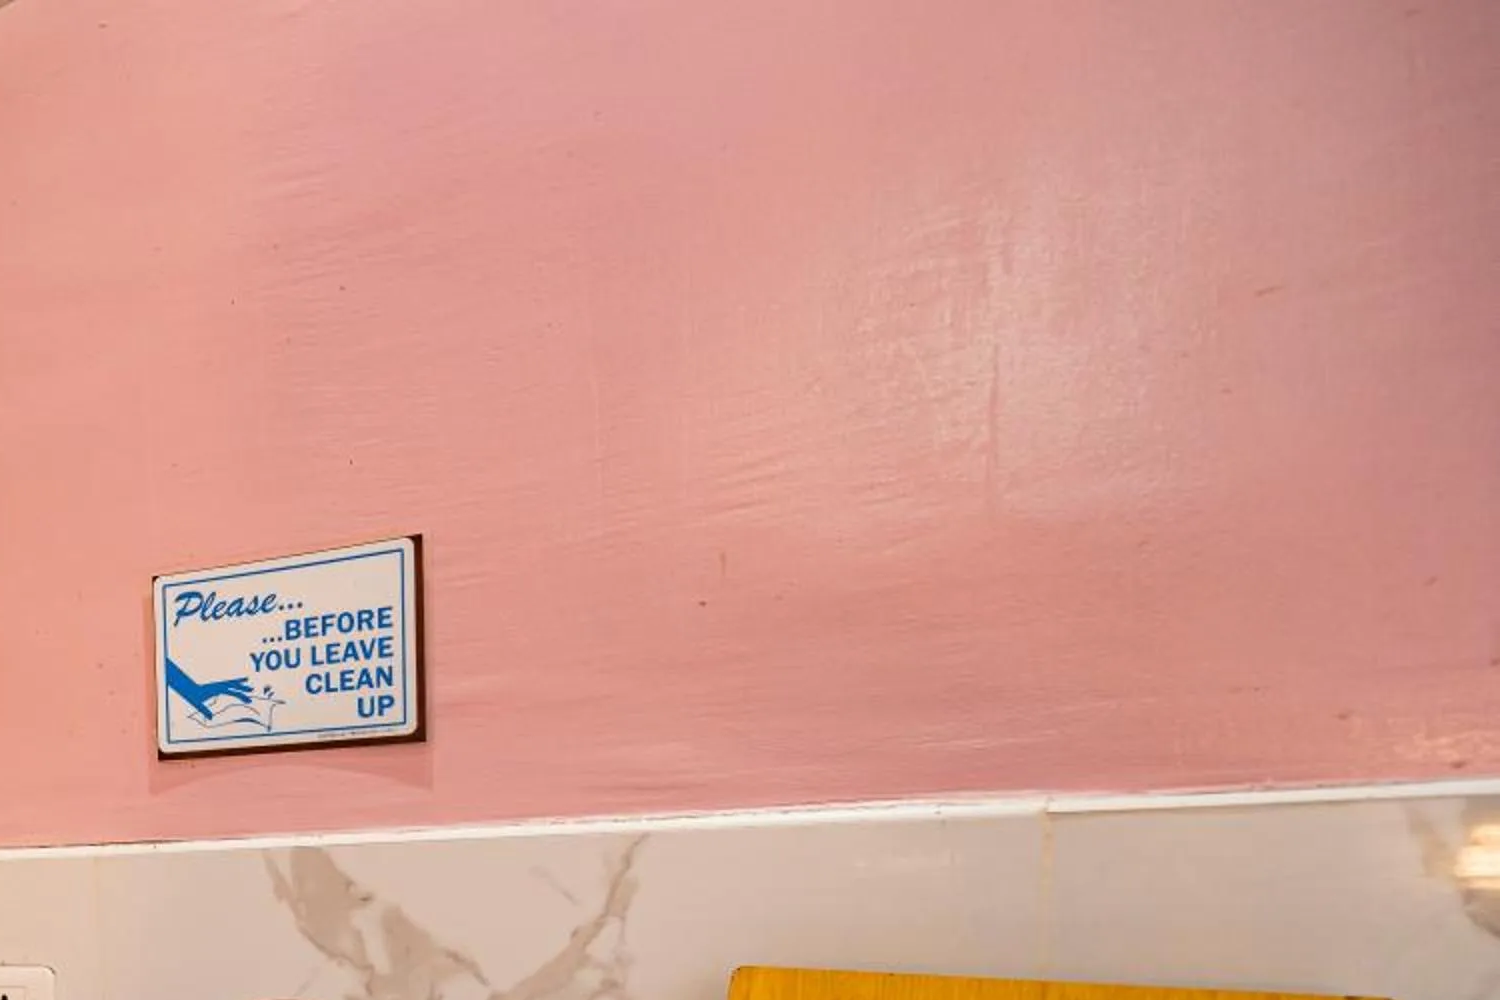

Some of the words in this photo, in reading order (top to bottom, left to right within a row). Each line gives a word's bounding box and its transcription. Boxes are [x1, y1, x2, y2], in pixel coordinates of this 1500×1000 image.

[172, 590, 303, 627] Please...
[262, 606, 393, 643] ...BEFORE
[249, 647, 301, 672] YOU
[311, 636, 394, 666] LEAVE
[305, 666, 393, 694] CLEAN
[357, 694, 395, 718] UP
